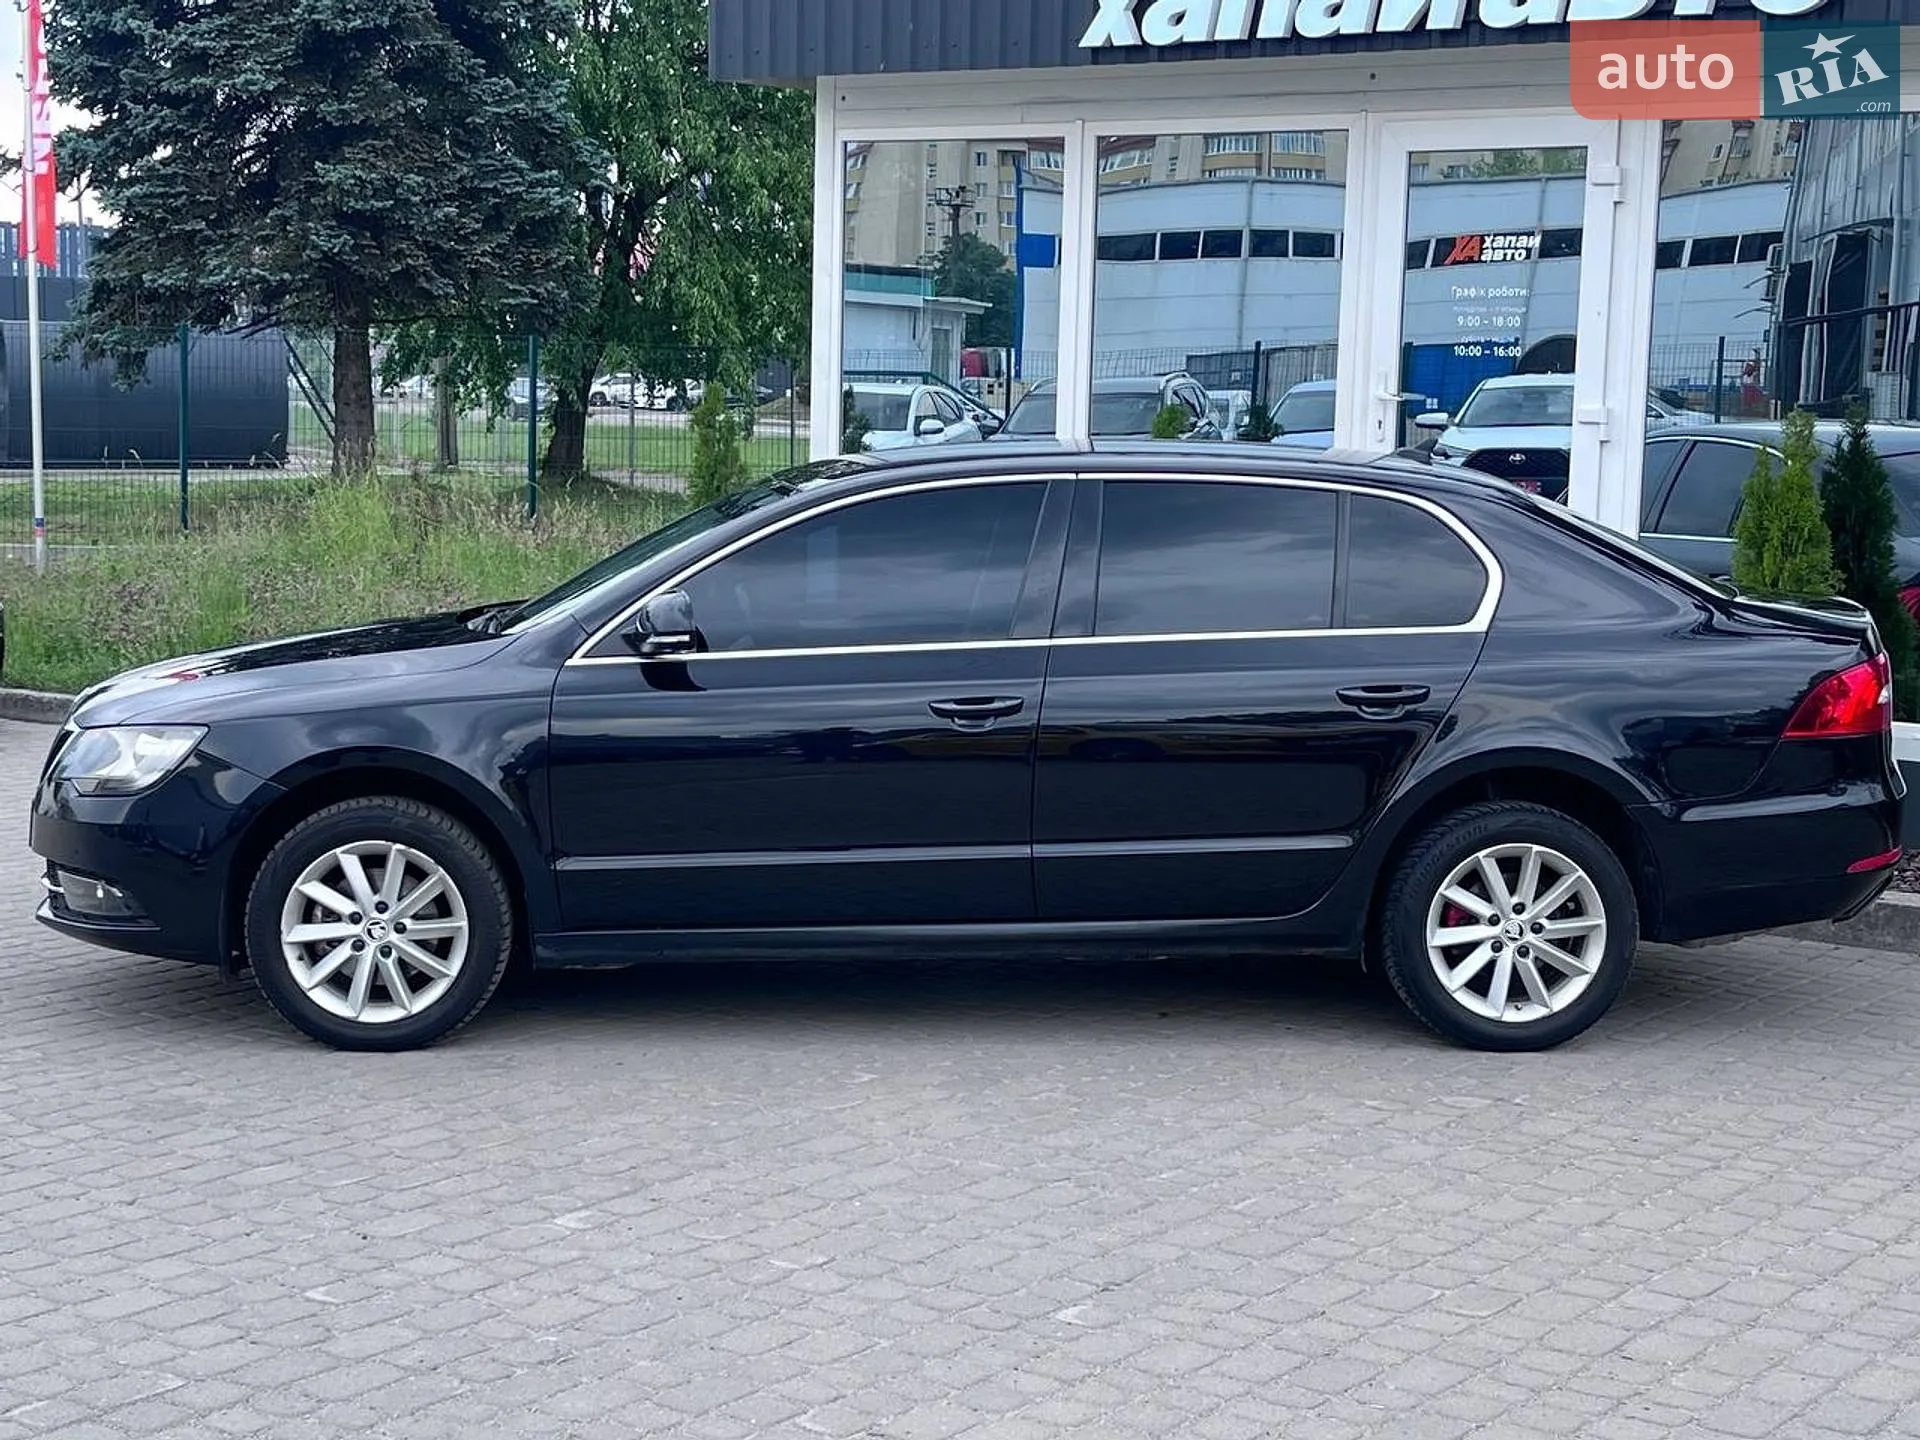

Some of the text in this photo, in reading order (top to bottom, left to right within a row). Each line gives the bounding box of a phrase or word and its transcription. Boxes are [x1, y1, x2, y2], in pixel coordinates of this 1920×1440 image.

[1480, 248, 1527, 261] авто
[1453, 345, 1482, 357] 10:00
[1493, 346, 1522, 357] 16:00
